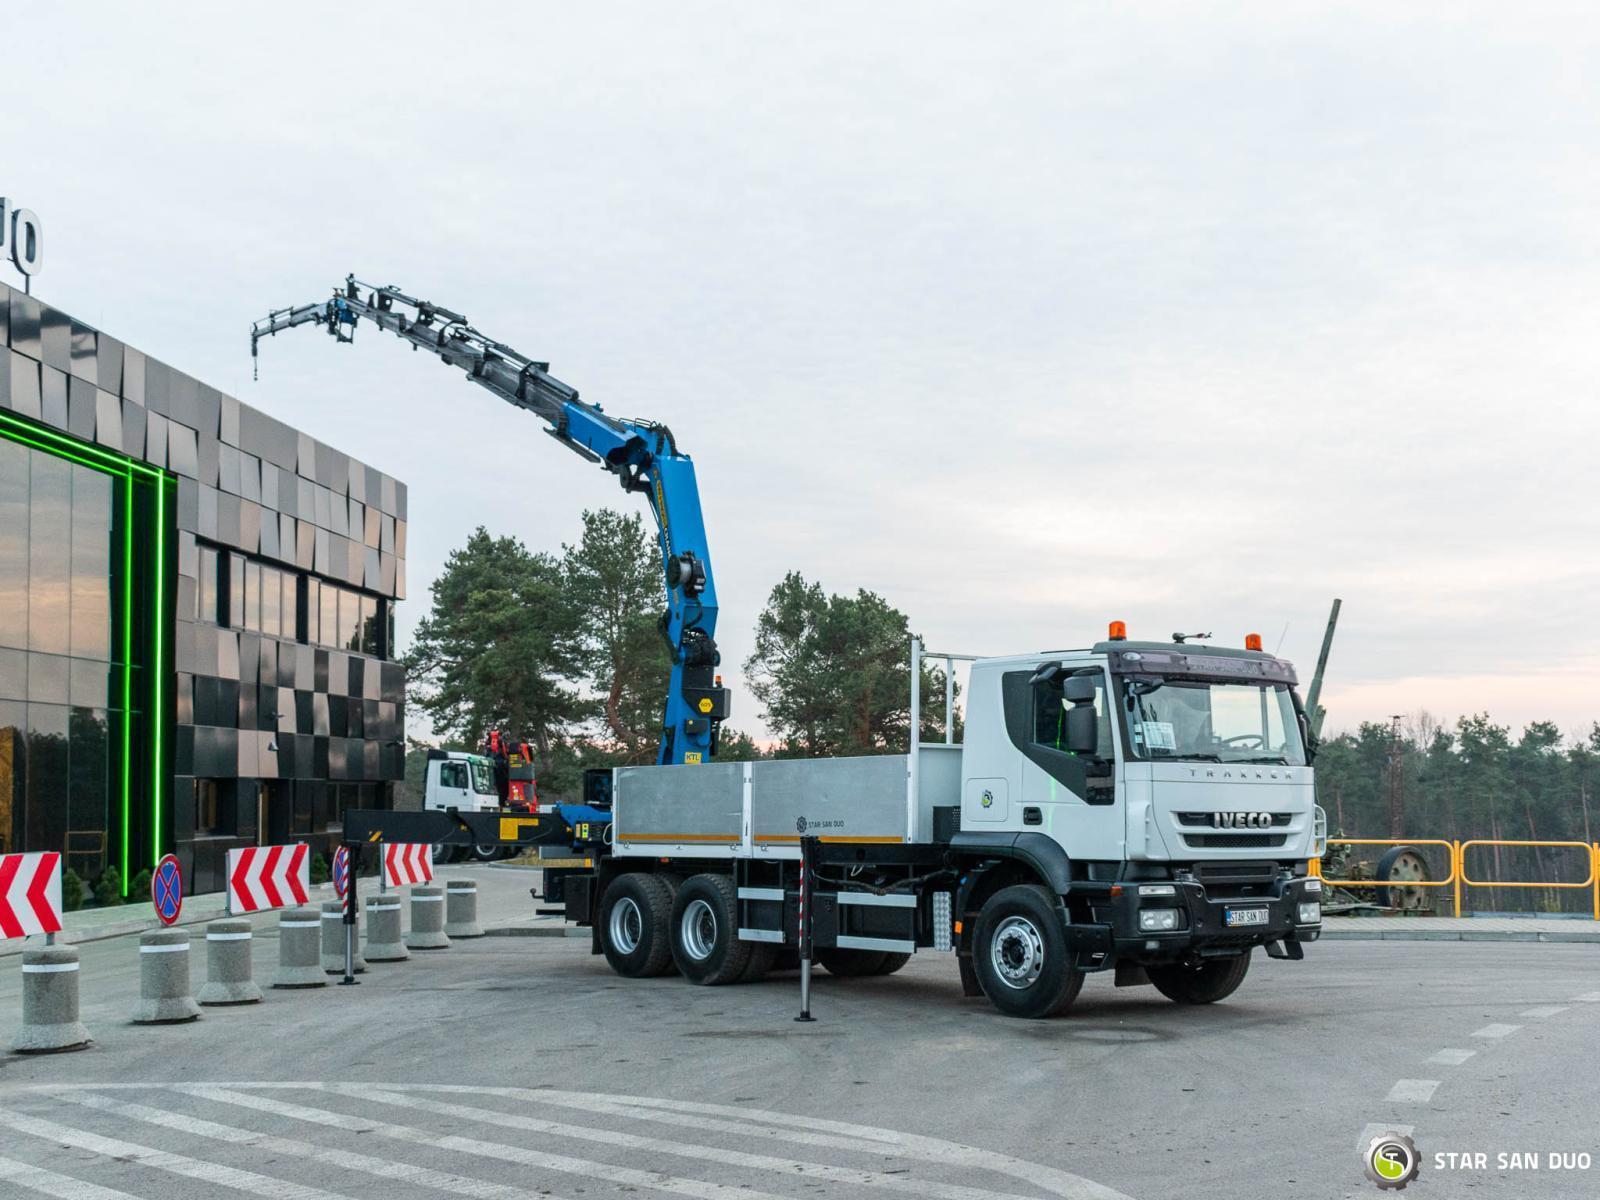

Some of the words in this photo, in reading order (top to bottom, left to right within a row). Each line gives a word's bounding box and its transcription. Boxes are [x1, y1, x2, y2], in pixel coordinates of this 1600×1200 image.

[1189, 768, 1292, 780] TRAKKER
[822, 820, 832, 828] SAN
[834, 820, 845, 828] DUO
[1214, 812, 1273, 829] IVECO
[1231, 911, 1245, 923] STAR
[1246, 911, 1257, 922] SAN
